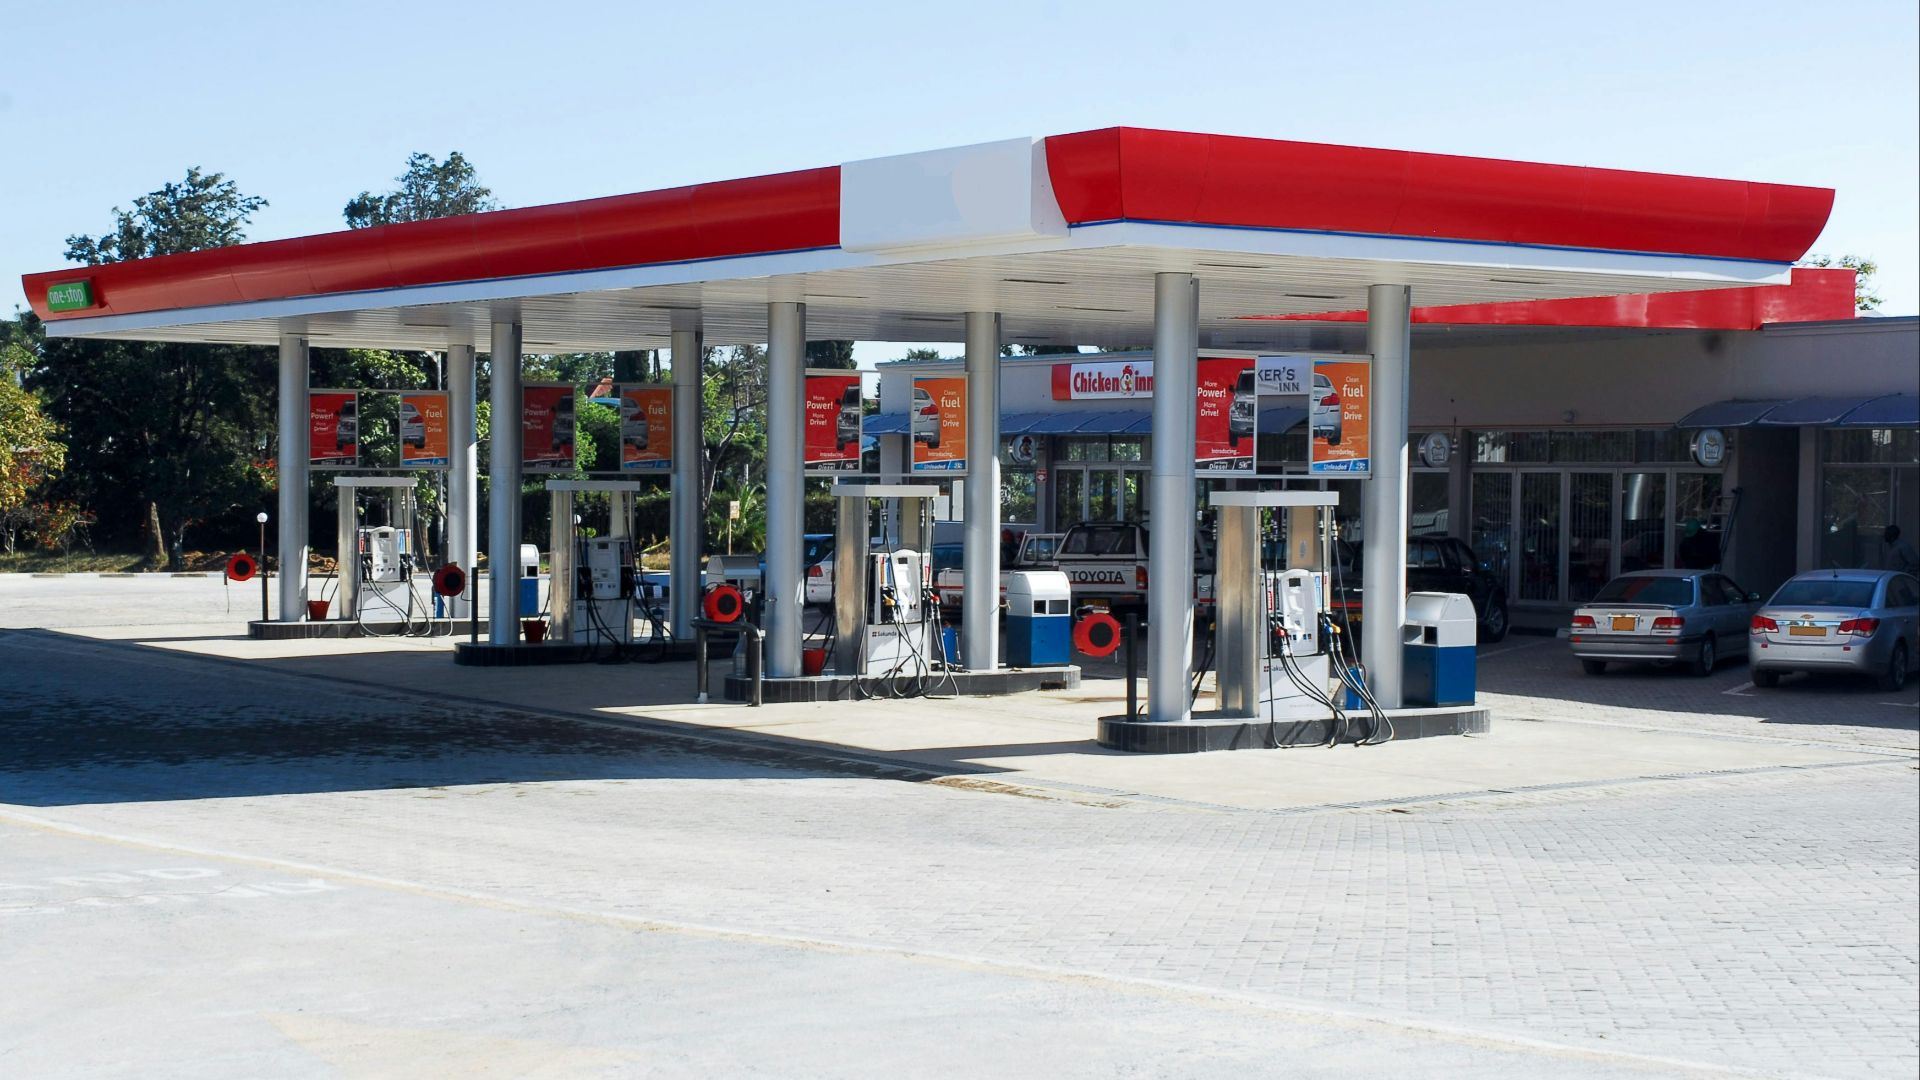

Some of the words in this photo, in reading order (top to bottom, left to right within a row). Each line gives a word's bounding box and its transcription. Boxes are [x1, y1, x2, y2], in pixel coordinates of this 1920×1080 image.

[50, 287, 84, 306] one-stop
[1073, 372, 1120, 392] Chicken
[1135, 370, 1153, 391] inn
[1197, 387, 1227, 398] Power!
[1279, 382, 1300, 392] INN
[1342, 384, 1364, 398] fuel
[806, 400, 834, 410] Power!
[940, 396, 960, 408] fuel
[425, 409, 443, 418] fuel
[648, 404, 666, 415] fuel
[1200, 409, 1219, 417] Drive!
[1344, 412, 1362, 420] Drive
[942, 420, 960, 428] Drive
[1070, 570, 1125, 582] TOYOTA
